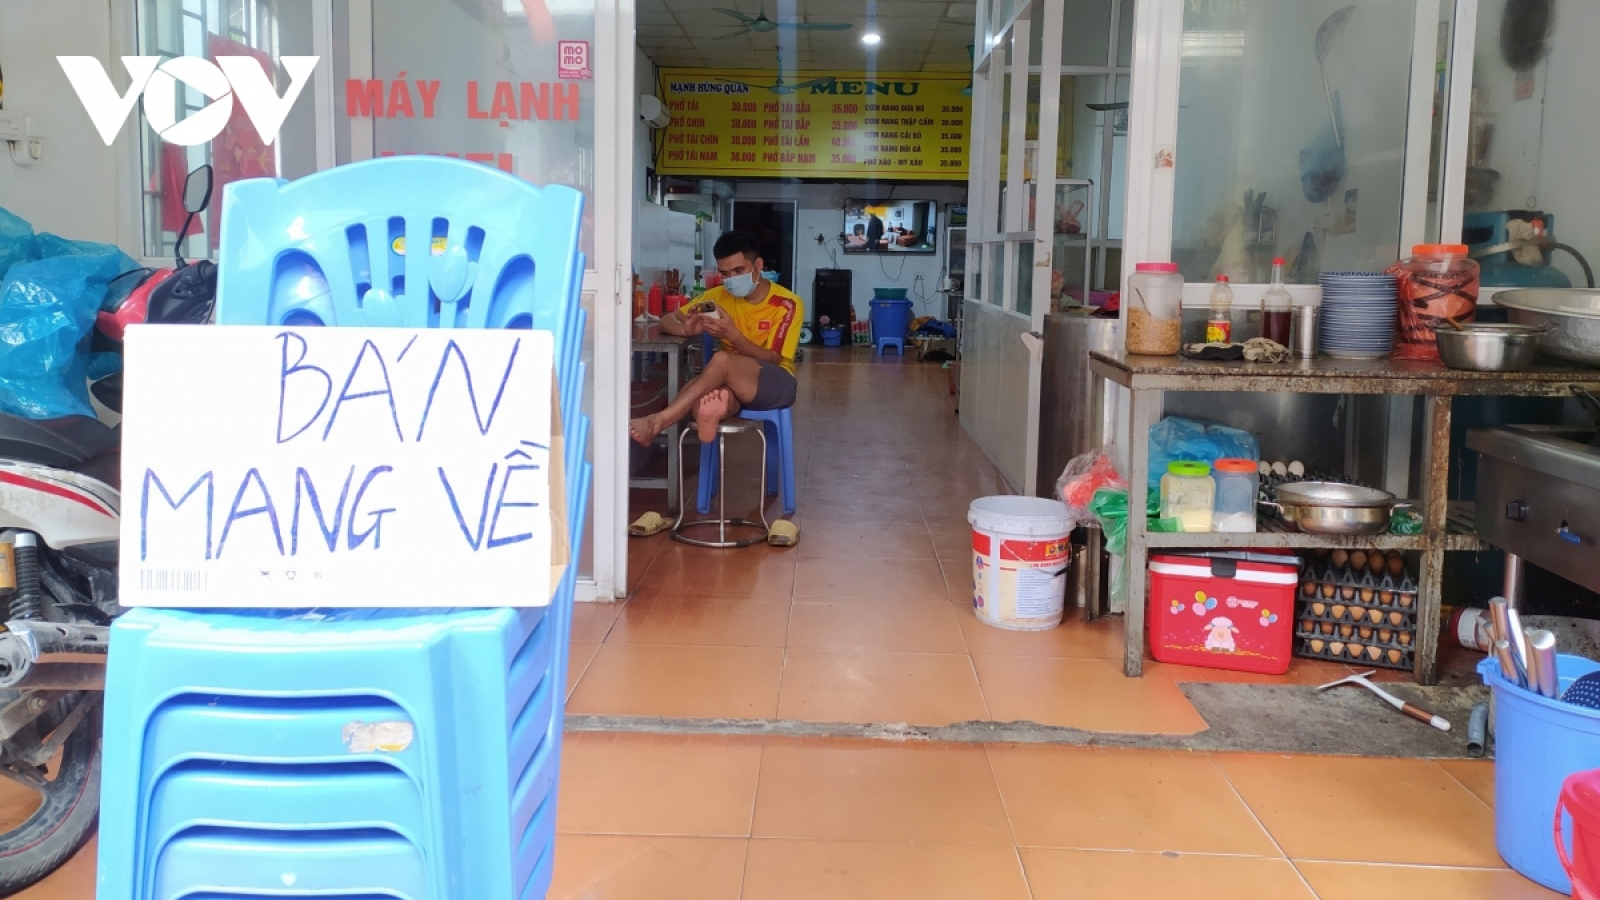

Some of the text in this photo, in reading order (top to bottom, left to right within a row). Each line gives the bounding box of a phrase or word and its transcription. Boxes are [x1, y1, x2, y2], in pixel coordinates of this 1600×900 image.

[563, 46, 583, 55] mo
[563, 55, 583, 65] mo
[670, 82, 695, 94] MẠNH
[809, 81, 920, 96] MENU
[345, 71, 580, 127] MÁY LẠNH
[669, 98, 757, 113] PHỞ TÁI 30.000
[764, 100, 779, 113] PHỞ
[781, 102, 793, 113] TÁI
[832, 104, 858, 114] 35.000
[669, 115, 757, 129] PHỞ CHÍN 30.000
[764, 116, 779, 129] PHỞ
[781, 118, 793, 129] TÁI
[832, 121, 858, 130] 35.000
[669, 131, 757, 146] PHỞ TÁI CHÍN 30.000
[763, 133, 779, 146] PHỞ
[781, 135, 793, 146] TÁI
[668, 148, 756, 163] PHỞ TÁI NẠM 30.000
[763, 150, 779, 162] PHỞ
[798, 153, 816, 165] NẠM
[831, 153, 857, 163] 35.000
[275, 331, 520, 443] BÁN
[140, 440, 549, 561] MANG VỀ
